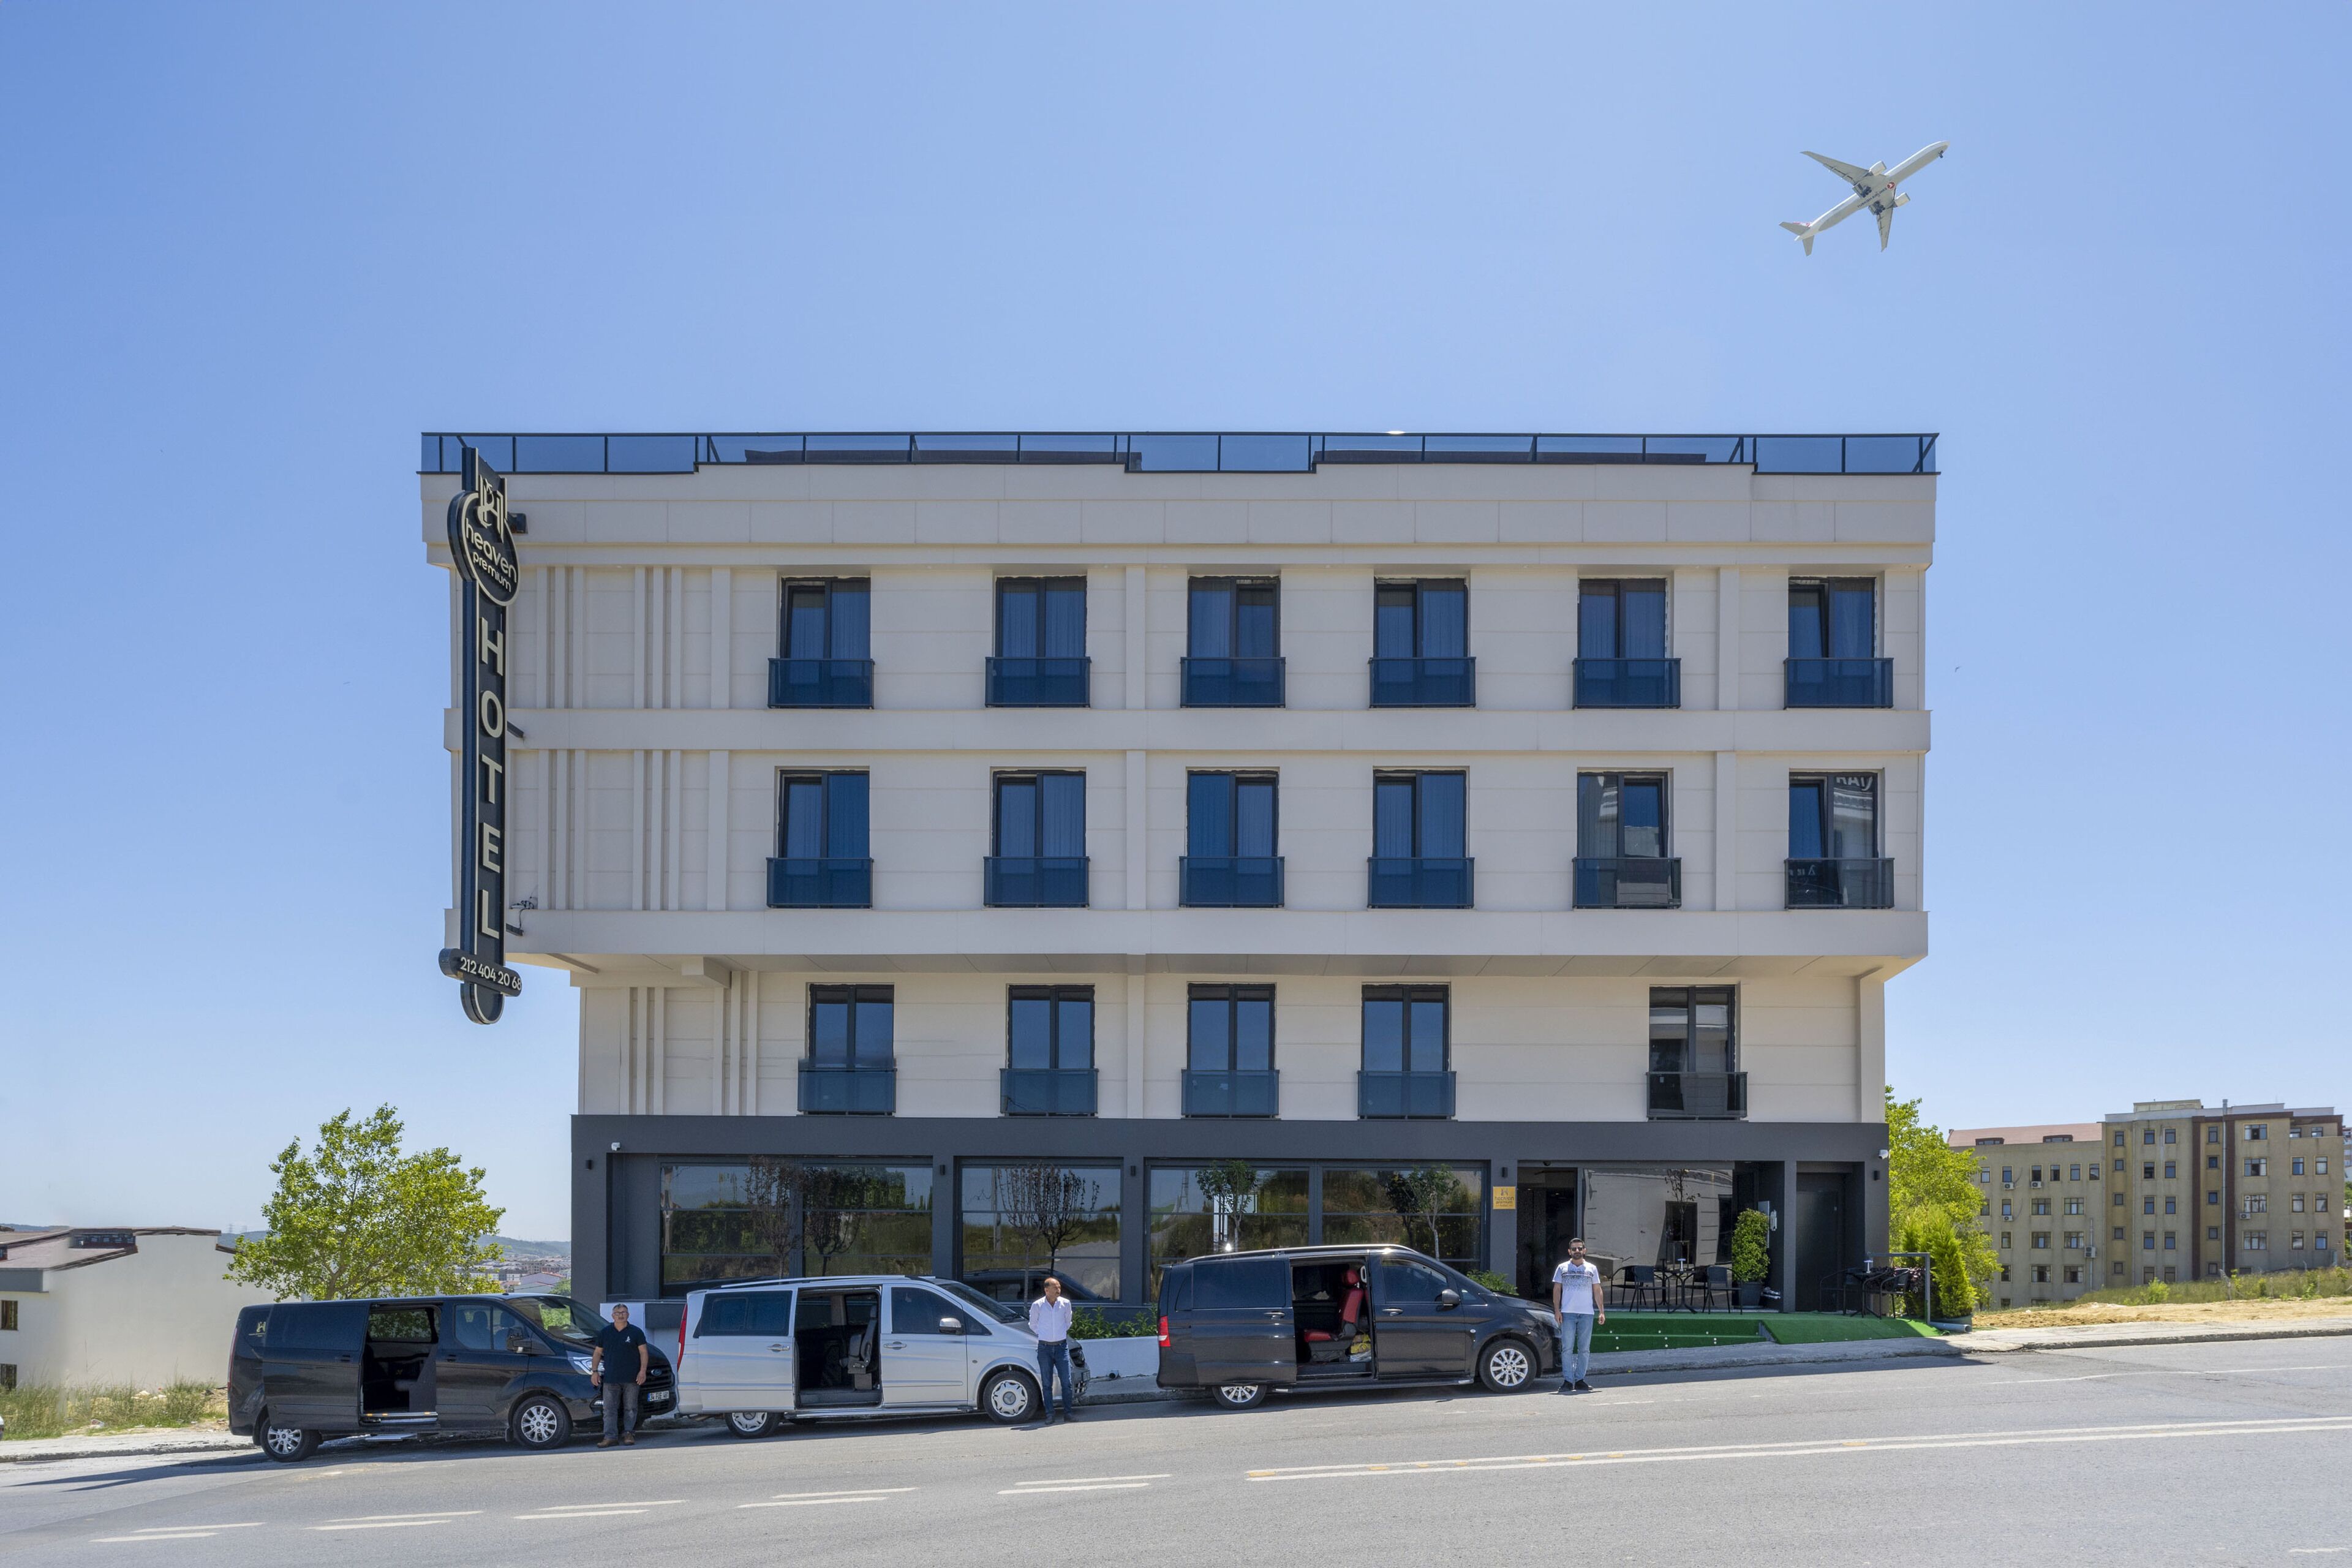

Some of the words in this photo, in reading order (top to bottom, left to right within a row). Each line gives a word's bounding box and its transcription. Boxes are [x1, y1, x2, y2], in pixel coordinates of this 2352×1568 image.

[466, 518, 516, 582] heaven
[473, 551, 511, 592] premium
[481, 617, 503, 939] HOTEL
[461, 957, 477, 974] 212
[478, 963, 496, 981] 404
[498, 971, 510, 986] 20
[512, 976, 522, 990] 68
